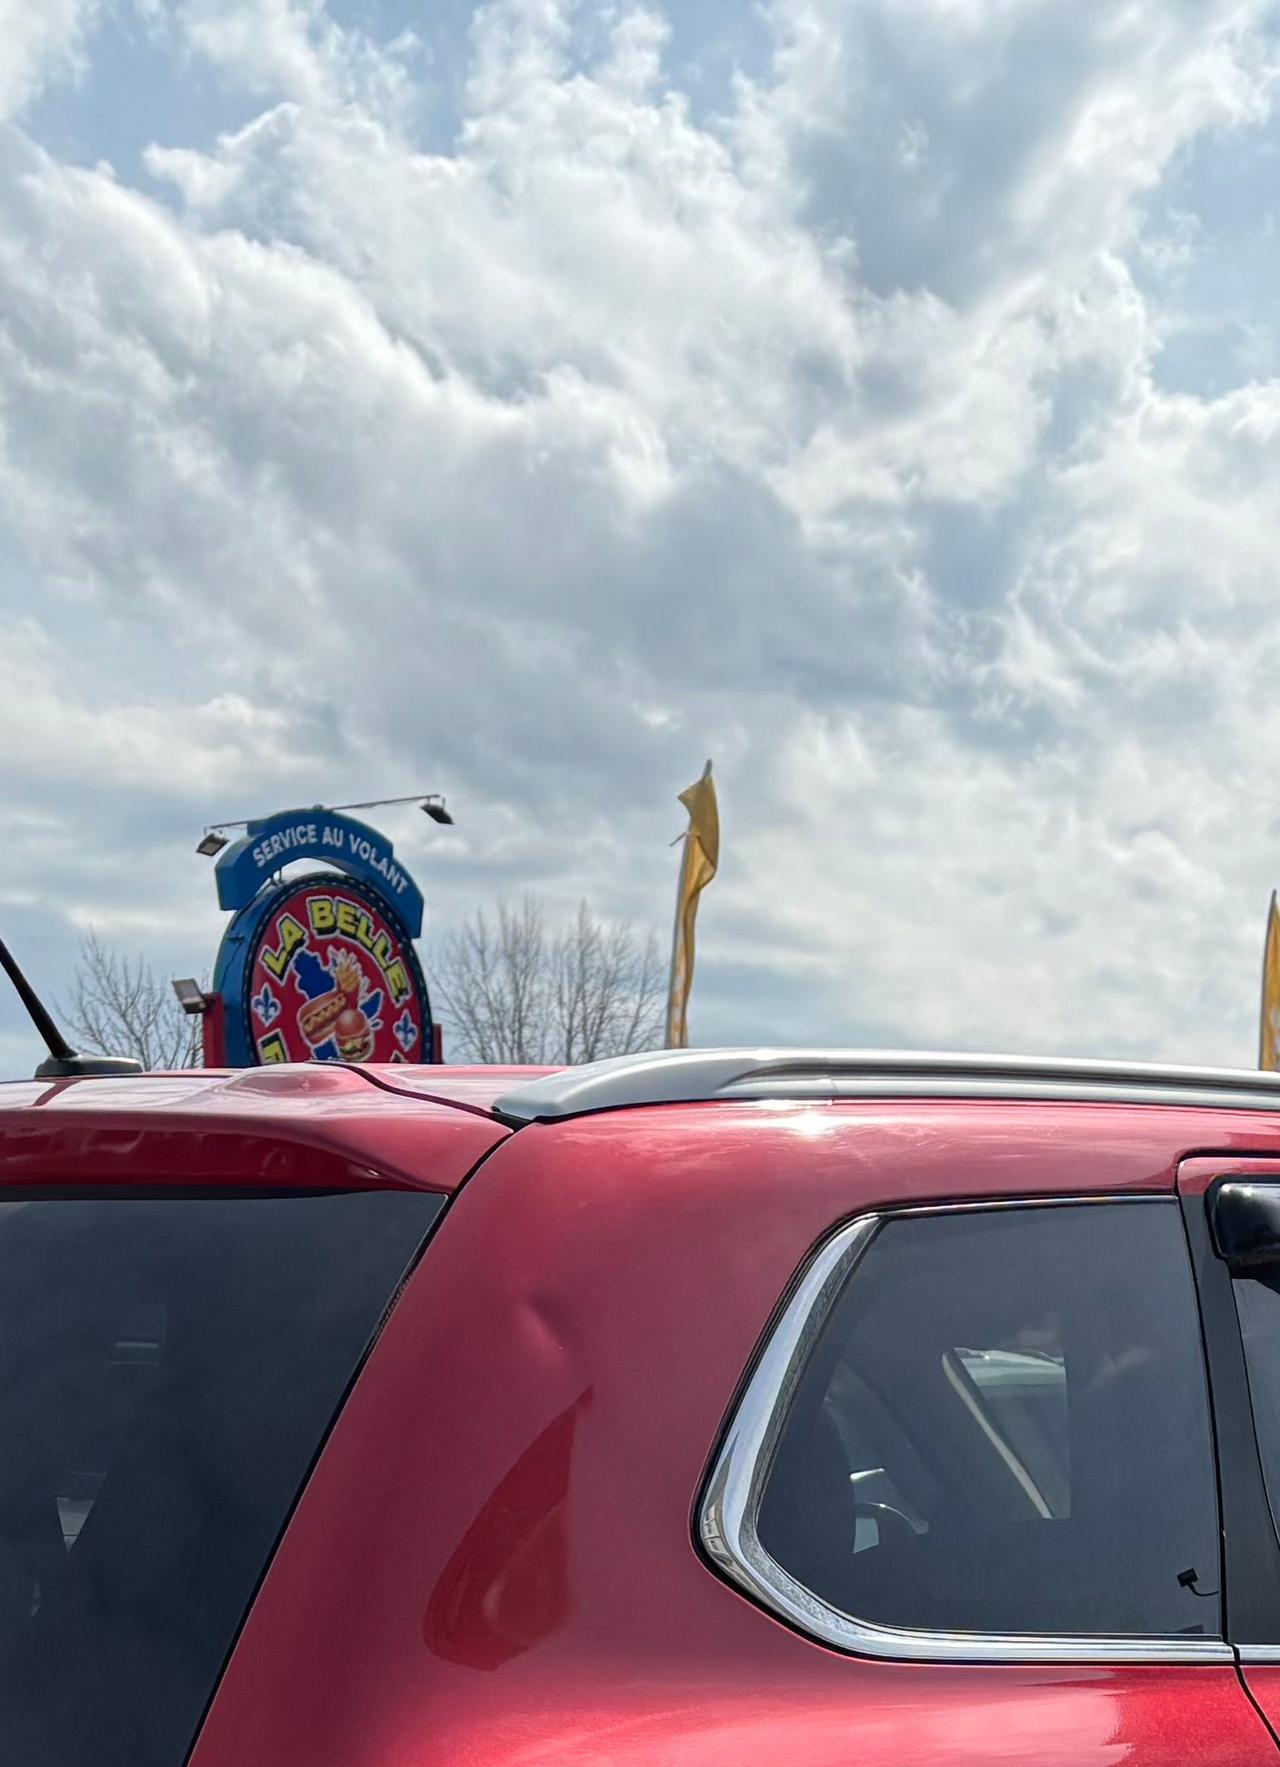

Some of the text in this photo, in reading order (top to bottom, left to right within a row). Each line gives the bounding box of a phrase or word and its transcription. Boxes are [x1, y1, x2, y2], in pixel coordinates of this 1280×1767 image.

[252, 824, 409, 895] SERVICE AU VOLANT
[261, 896, 412, 1006] LA BELLE
